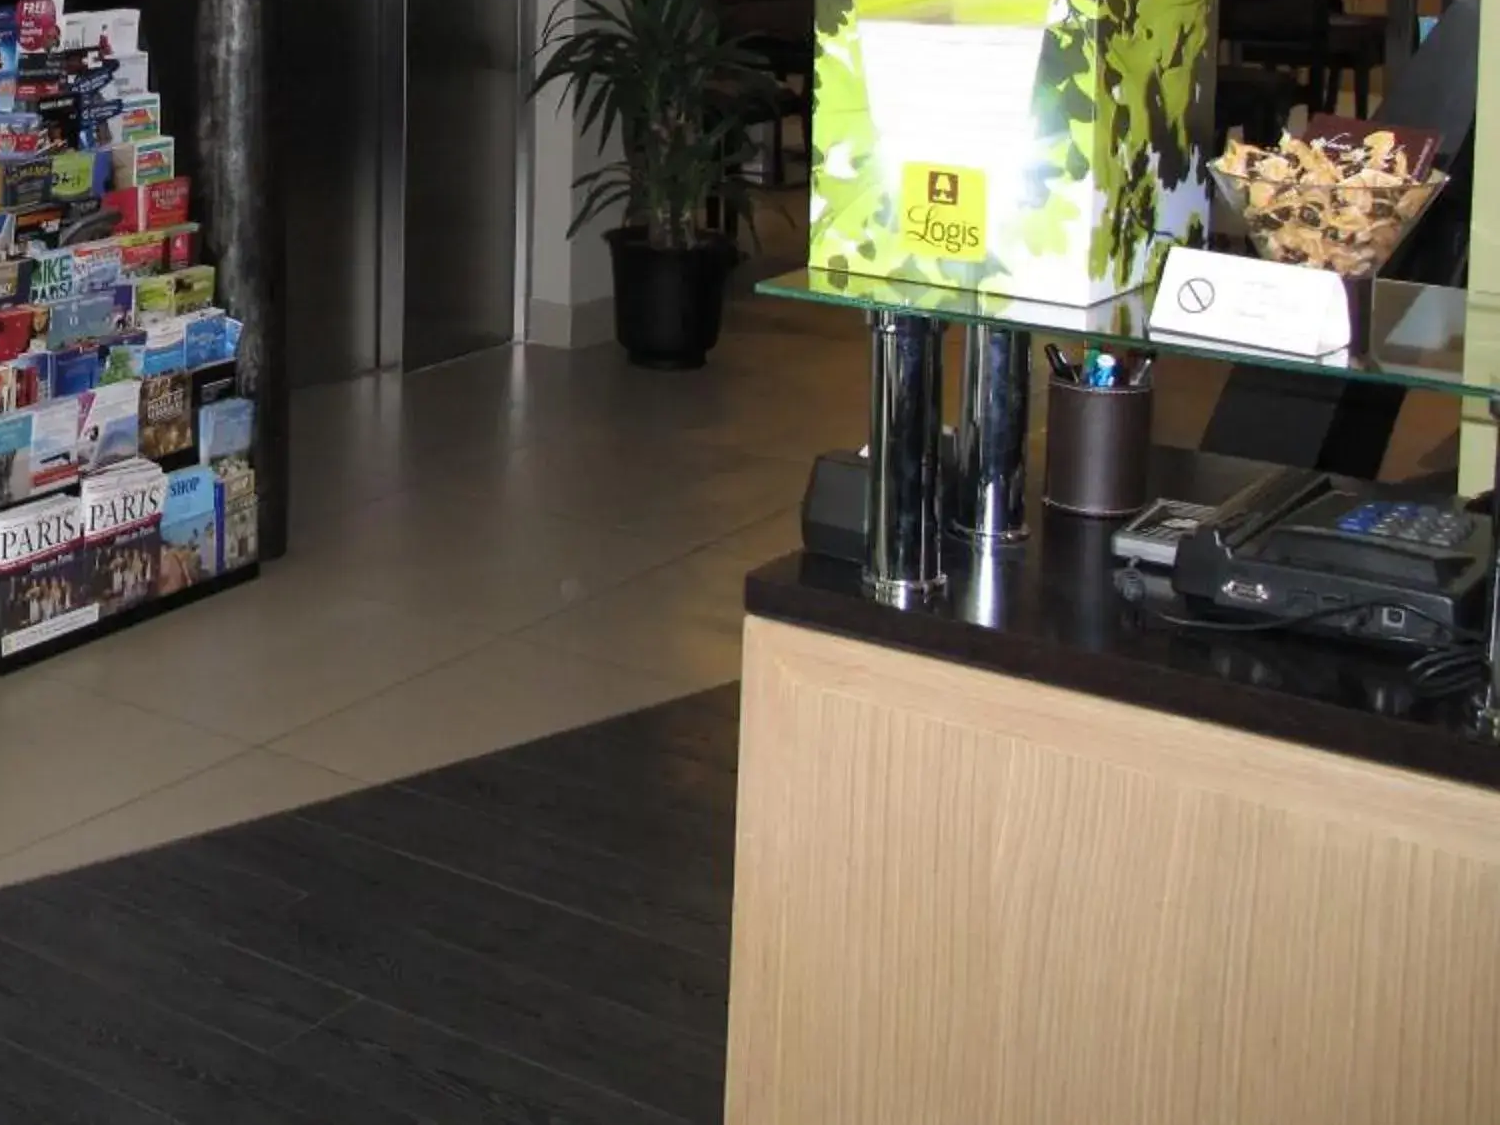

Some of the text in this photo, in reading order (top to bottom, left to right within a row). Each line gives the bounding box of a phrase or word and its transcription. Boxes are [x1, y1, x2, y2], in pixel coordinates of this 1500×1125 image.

[906, 204, 980, 254] Logis
[90, 487, 160, 531] PARIS
[170, 475, 201, 497] SHOP
[0, 507, 75, 560] PARIS
